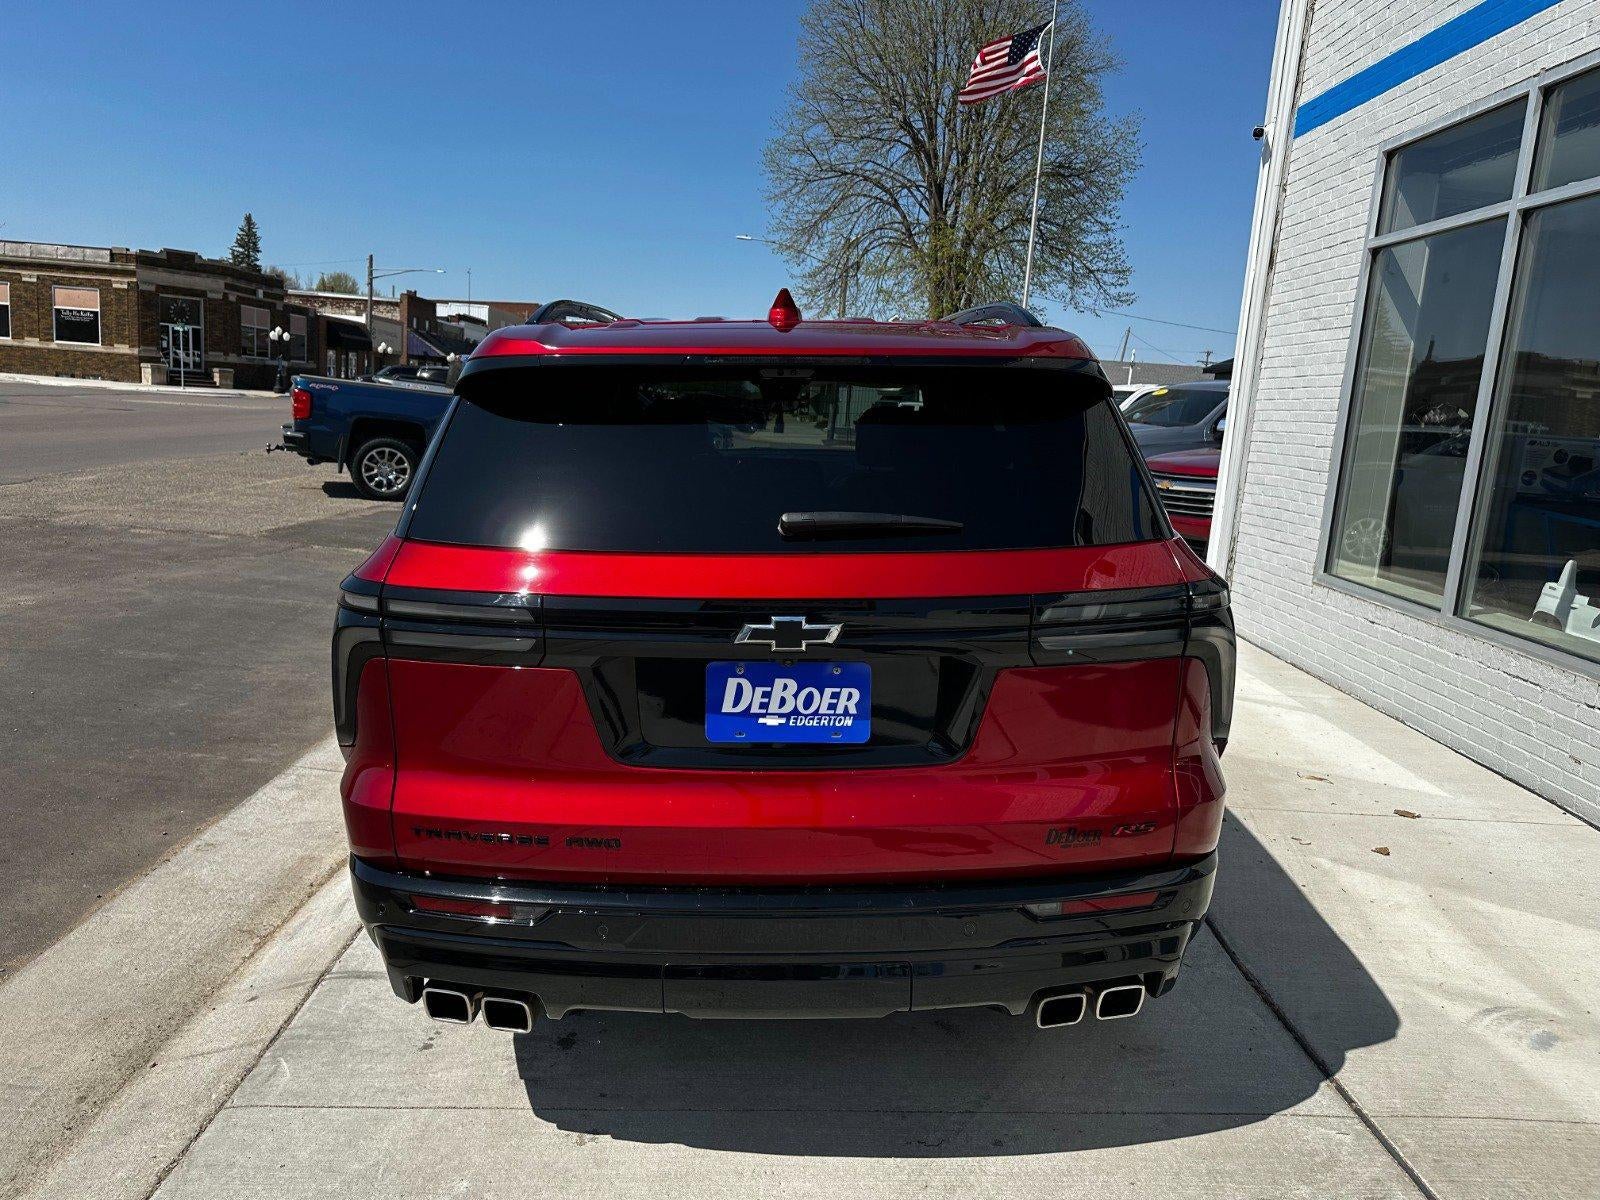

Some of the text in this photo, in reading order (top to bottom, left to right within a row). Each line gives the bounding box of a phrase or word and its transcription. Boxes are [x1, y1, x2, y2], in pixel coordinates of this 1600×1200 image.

[789, 715, 853, 727] EDGERTON
[1111, 821, 1158, 836] RS
[412, 826, 621, 849] TRAVERSE AWD
